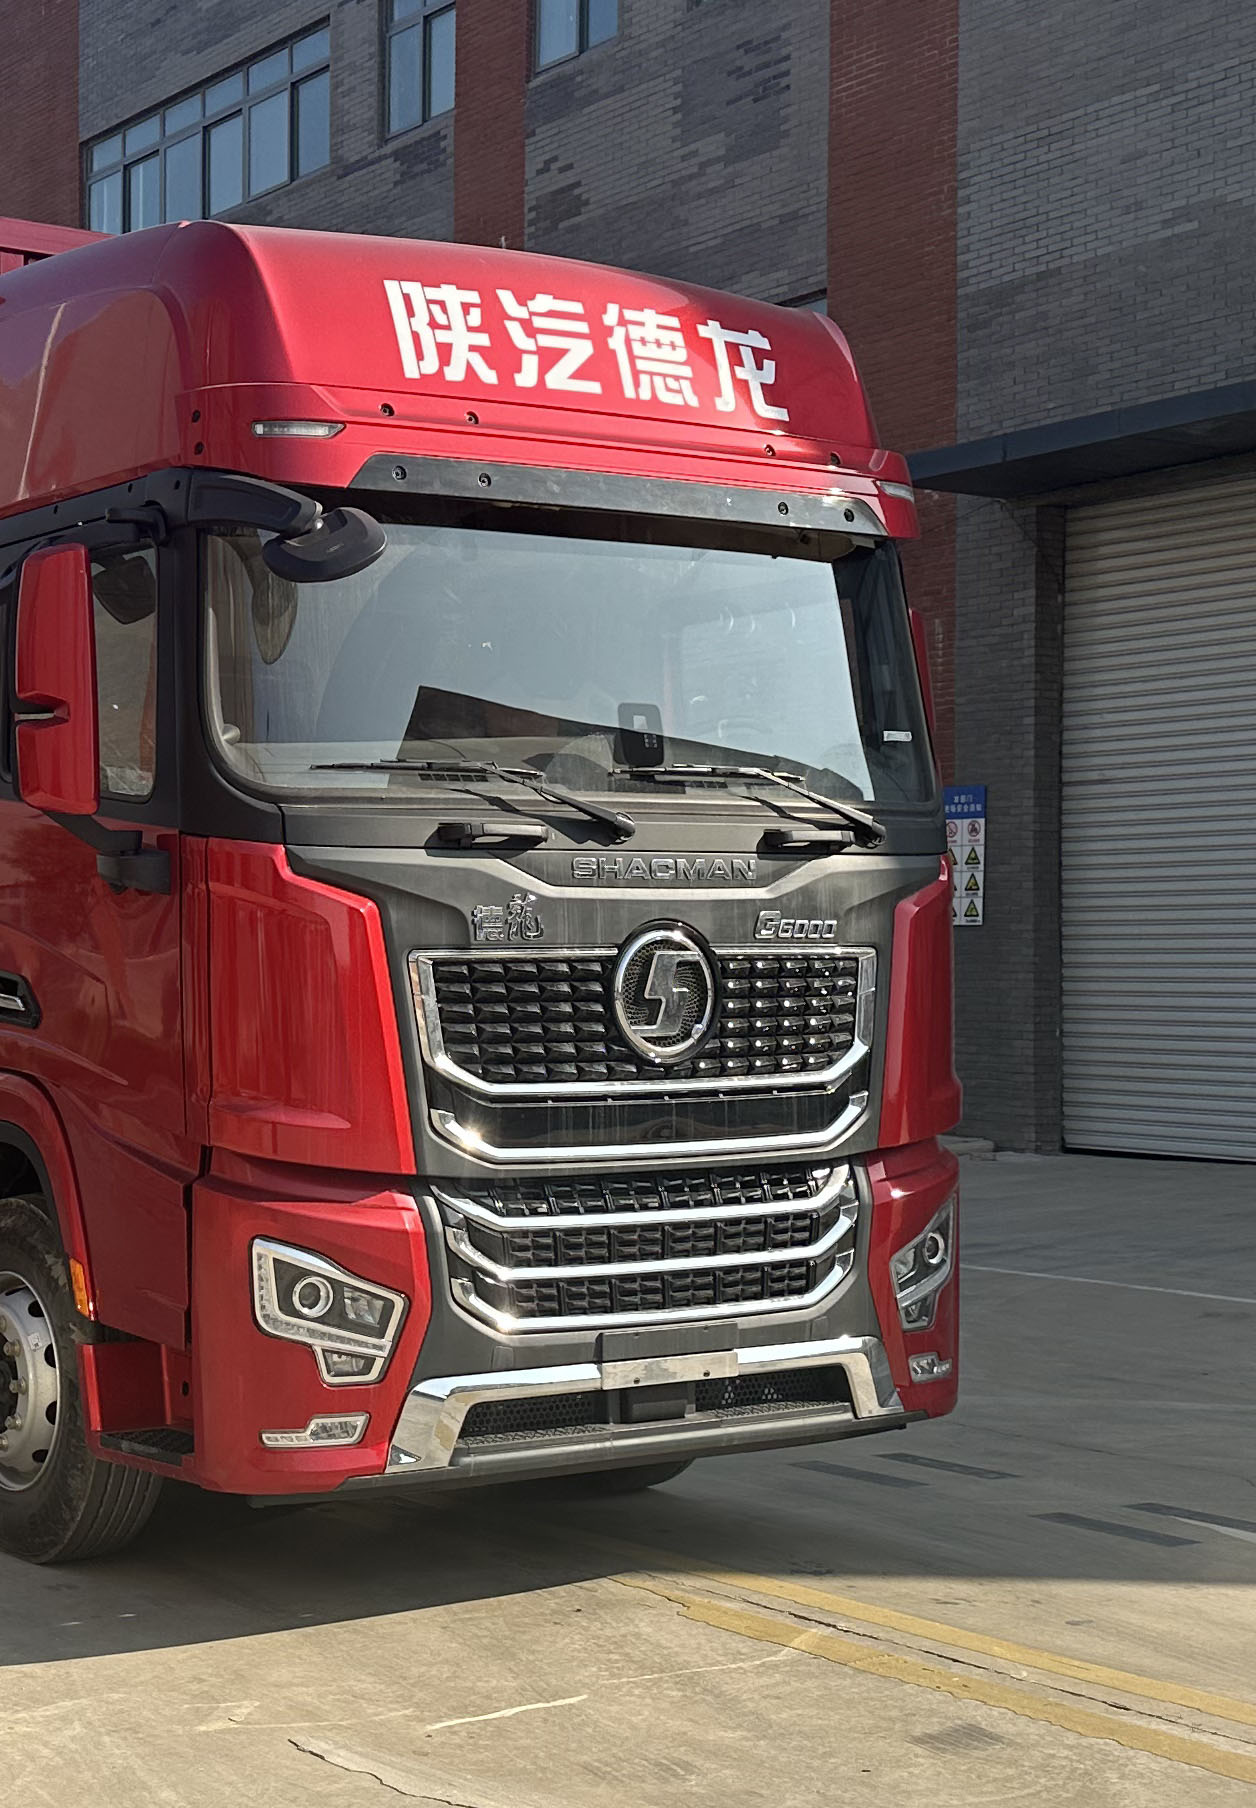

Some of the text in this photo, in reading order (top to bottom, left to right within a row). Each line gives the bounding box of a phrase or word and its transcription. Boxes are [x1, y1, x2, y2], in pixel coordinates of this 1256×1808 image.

[383, 279, 790, 422] 陕汽德龙
[572, 856, 757, 880] SHACMAN
